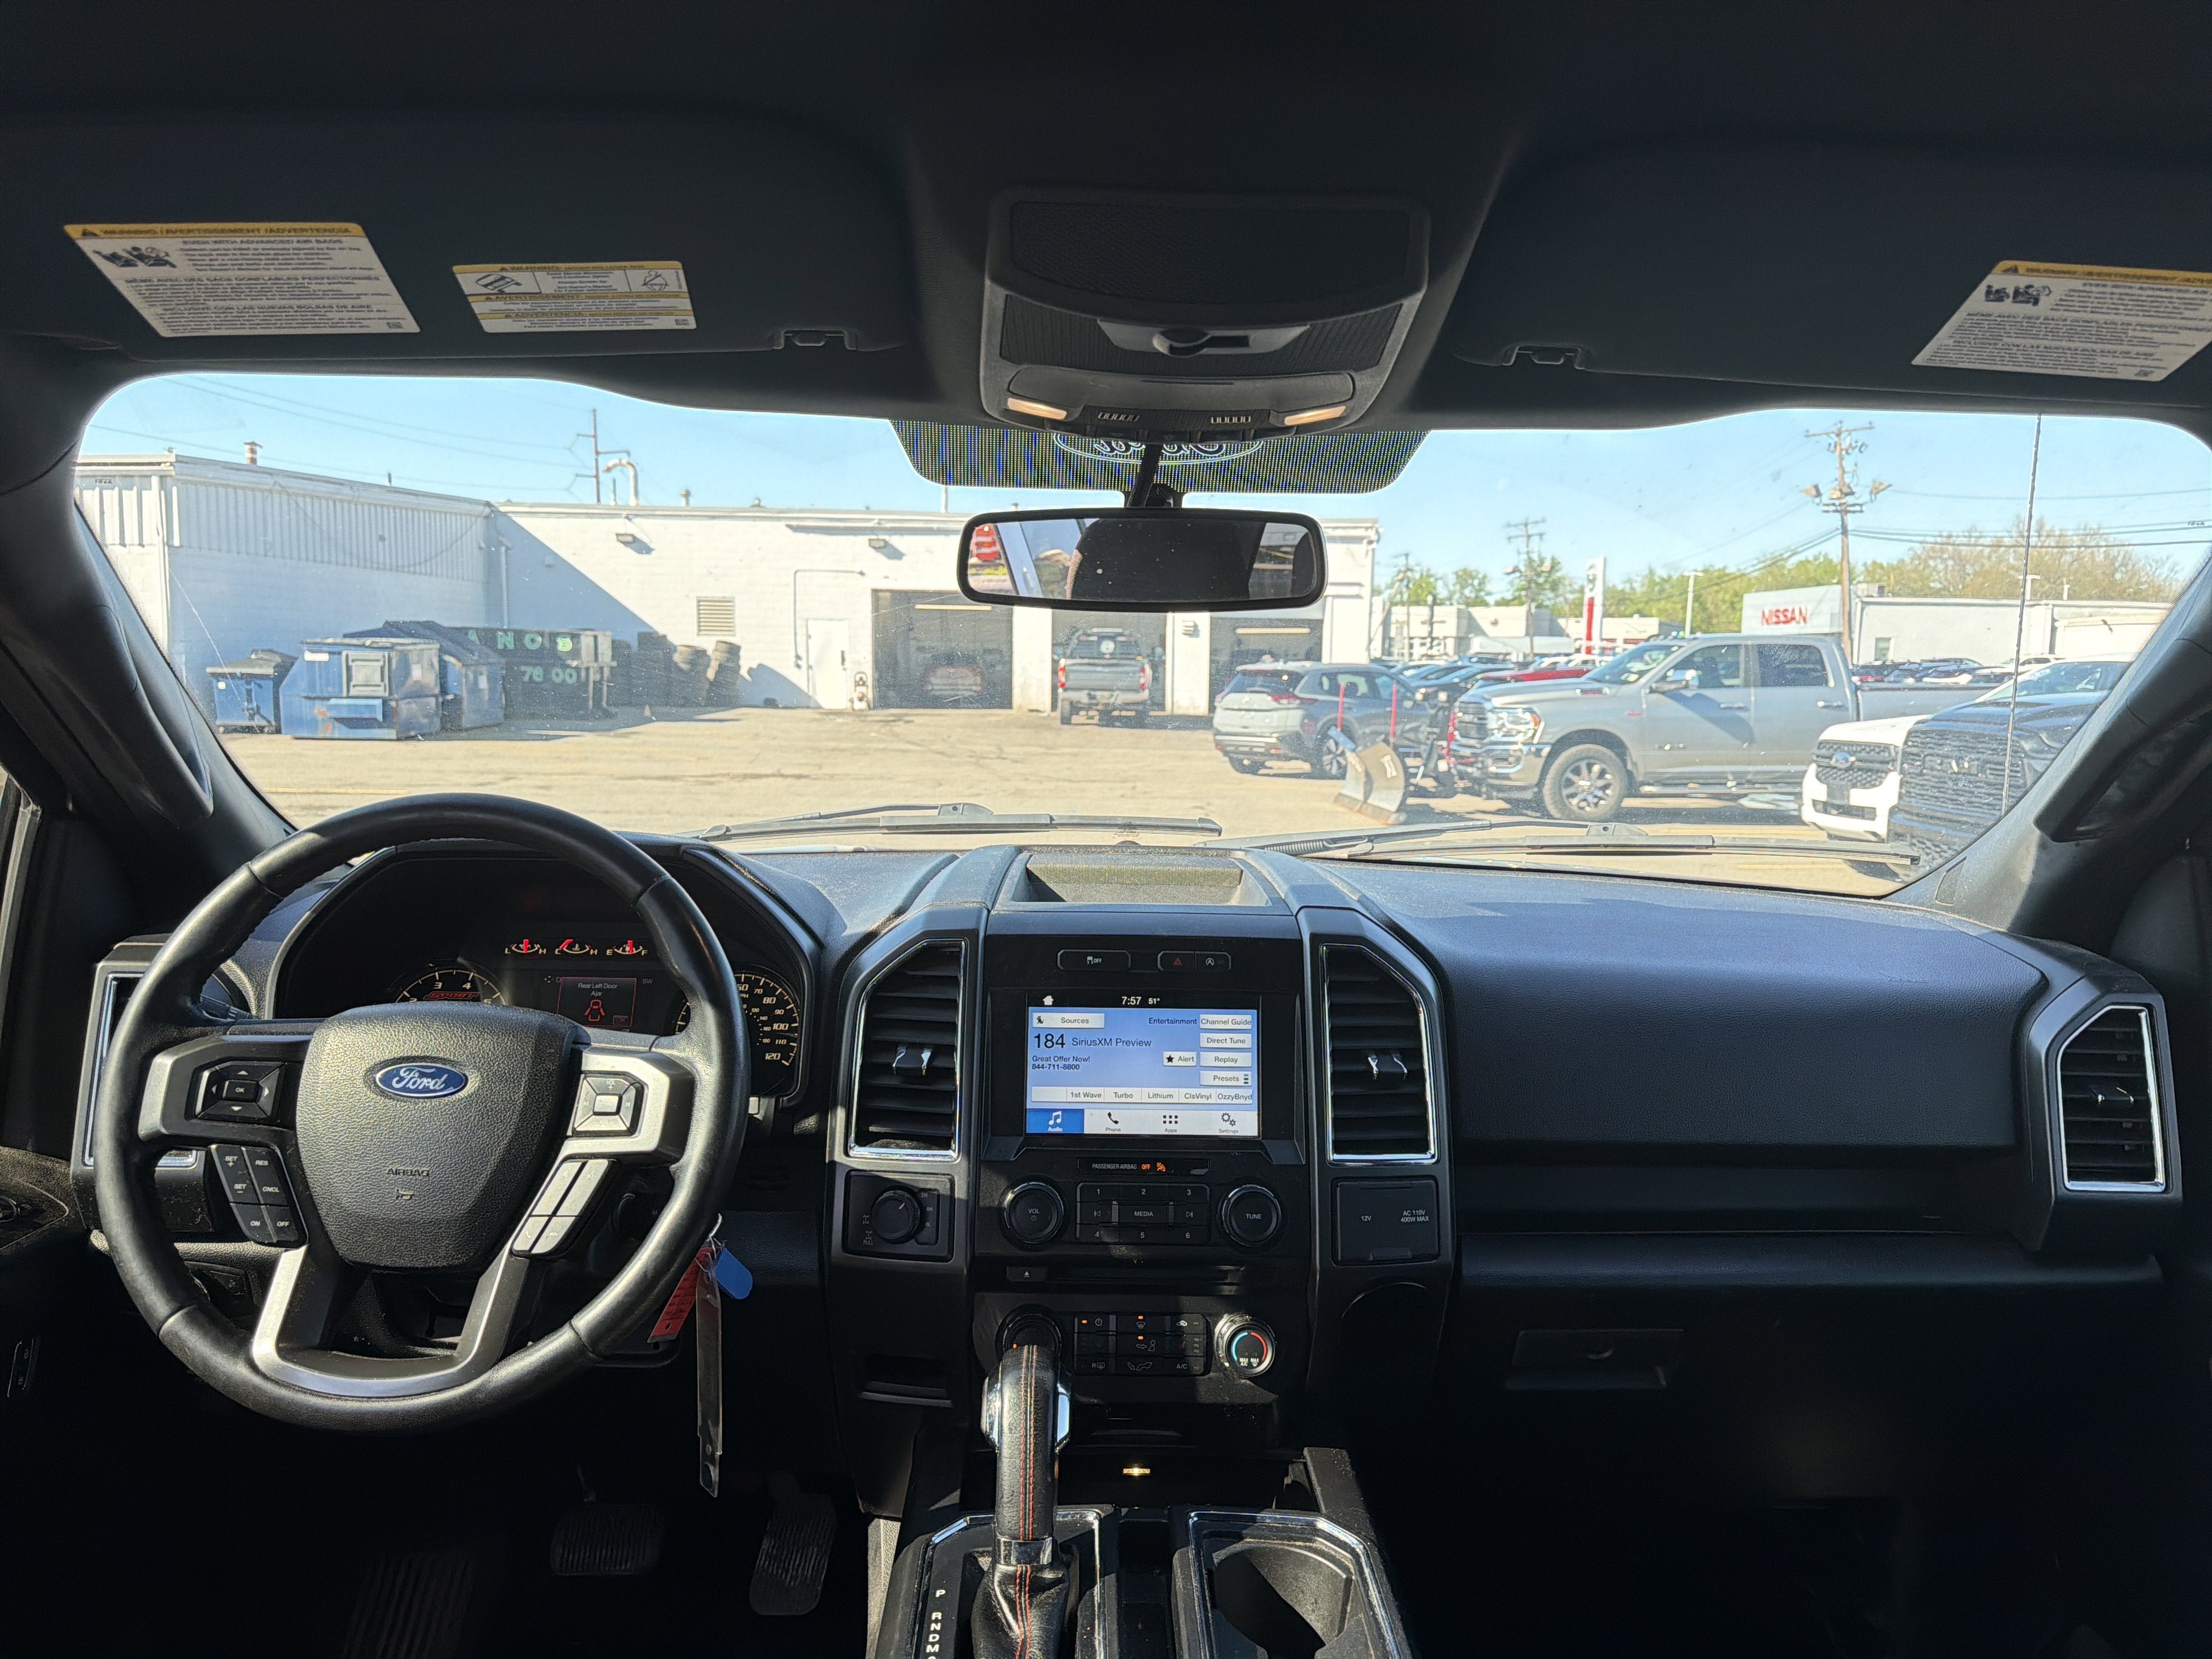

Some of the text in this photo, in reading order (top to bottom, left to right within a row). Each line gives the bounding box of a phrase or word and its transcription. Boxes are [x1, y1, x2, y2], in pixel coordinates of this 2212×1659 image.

[1762, 606, 1808, 624] NISSAN
[1121, 996, 1141, 1005] 7:57
[1034, 1033, 1152, 1048] 184 SiriusXM Preview
[1214, 1056, 1238, 1064] Replay
[392, 1066, 449, 1090] Ford
[1184, 1092, 1212, 1101] ClsVinyl
[1217, 1092, 1252, 1102] OzzyBnyd
[386, 1168, 430, 1177] AIRBAG
[935, 1589, 946, 1598] P
[931, 1612, 942, 1620] R
[928, 1634, 940, 1642] D
[926, 1644, 940, 1653] M
